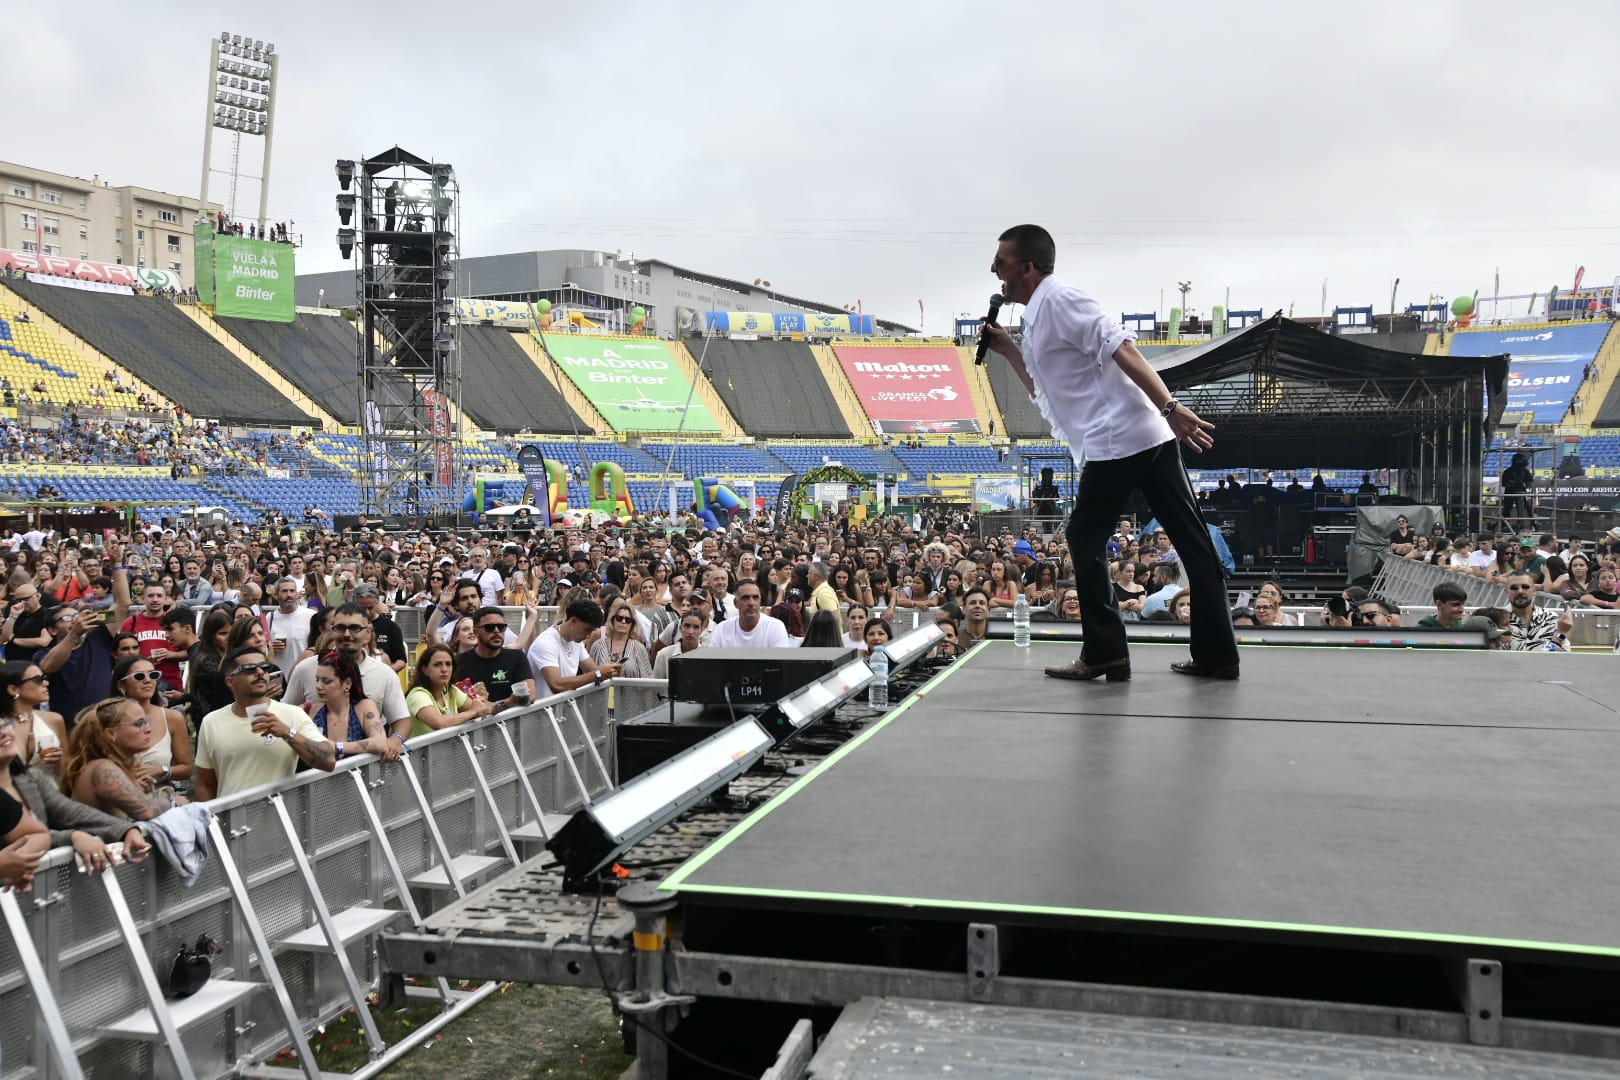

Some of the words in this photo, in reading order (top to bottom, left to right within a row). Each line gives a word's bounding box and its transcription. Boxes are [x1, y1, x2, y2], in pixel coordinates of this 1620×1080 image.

[10, 252, 131, 280] SPAR
[232, 252, 267, 265] VUELA
[269, 257, 277, 267] A
[232, 265, 279, 280] MADRID
[235, 285, 276, 301] Binter
[780, 321, 799, 329] PLAY
[602, 348, 622, 359] A
[563, 356, 669, 370] MADRID
[853, 361, 953, 373] Mahou
[588, 371, 668, 385] Binter
[1507, 375, 1571, 387] OLSEN
[741, 686, 762, 696] LP11
